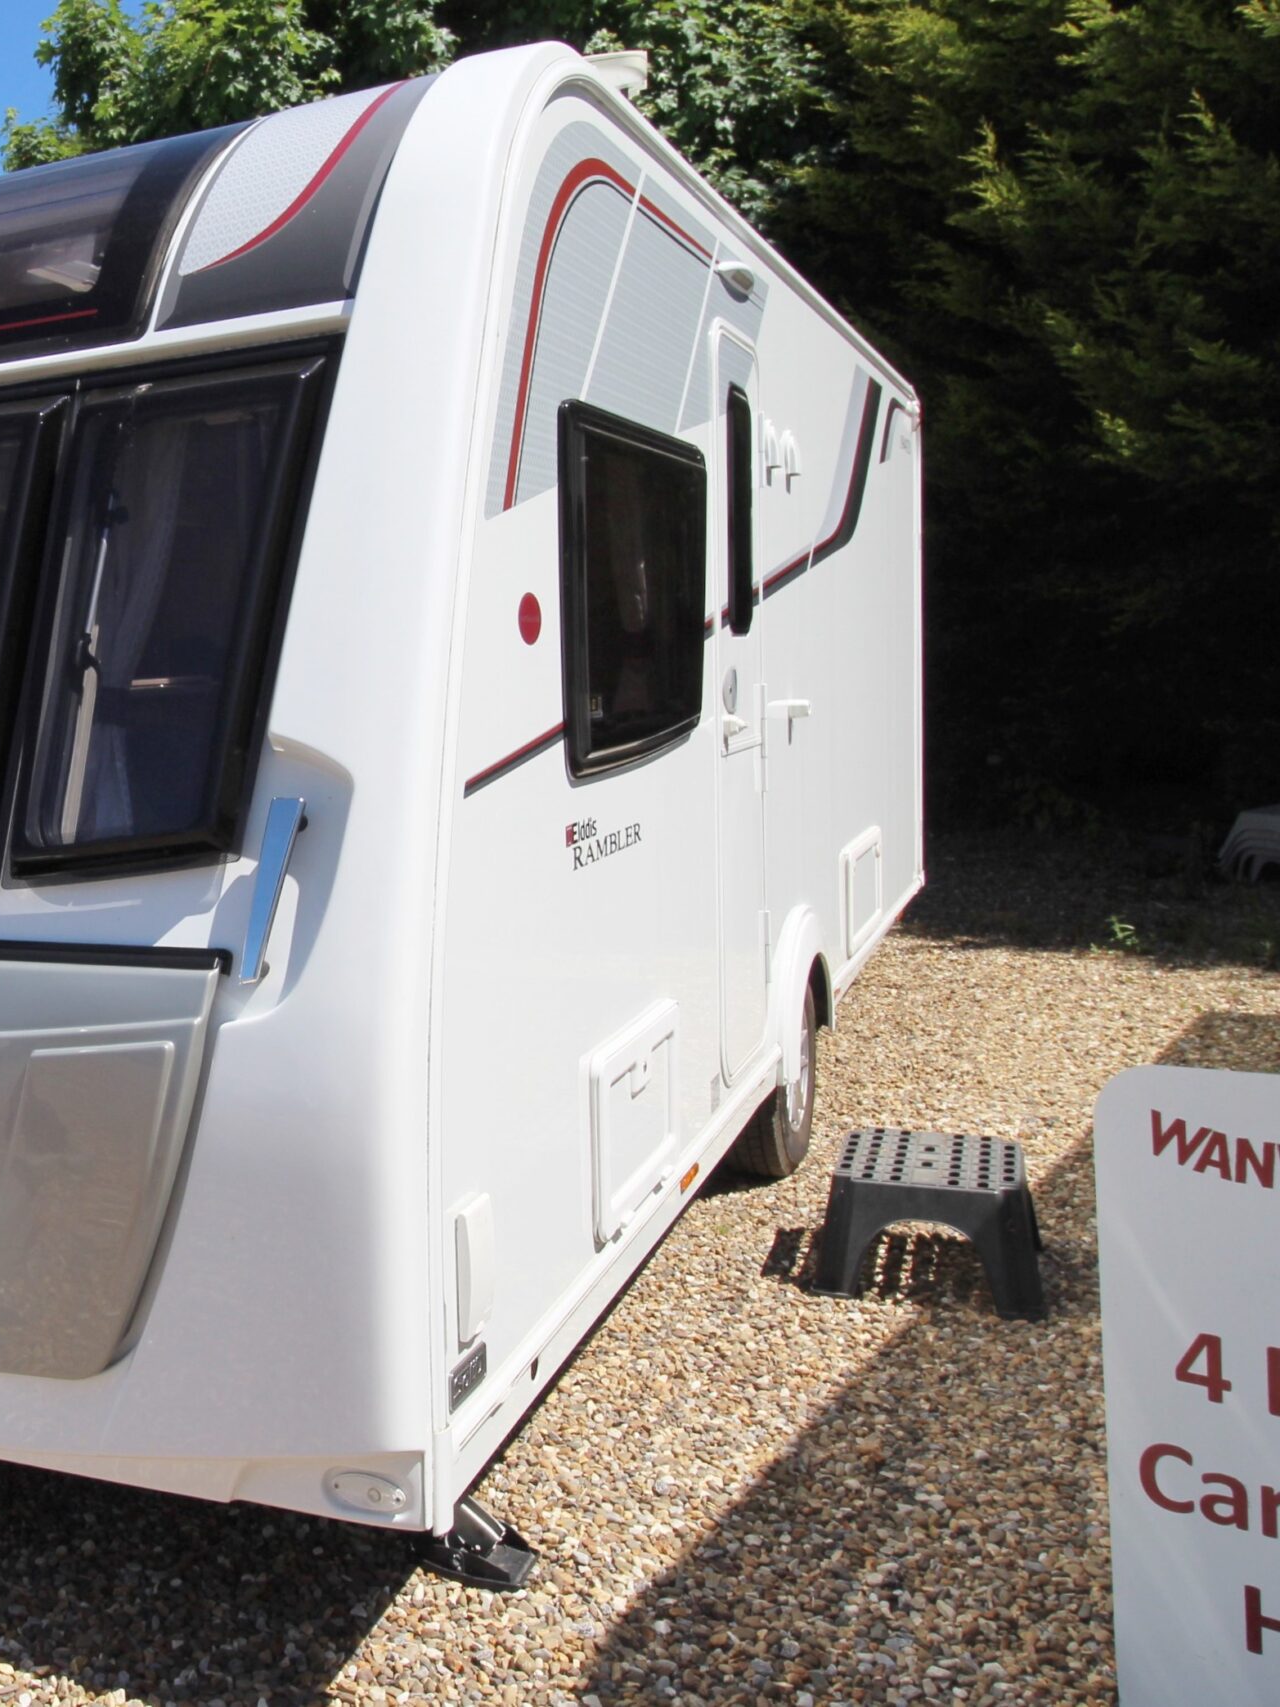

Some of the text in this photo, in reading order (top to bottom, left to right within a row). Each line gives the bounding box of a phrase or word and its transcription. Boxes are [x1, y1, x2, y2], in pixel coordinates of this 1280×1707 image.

[570, 817, 598, 845] Elddis
[573, 822, 642, 871] RAMBLER
[1151, 1109, 1280, 1189] WAN
[1175, 1333, 1232, 1404] 4
